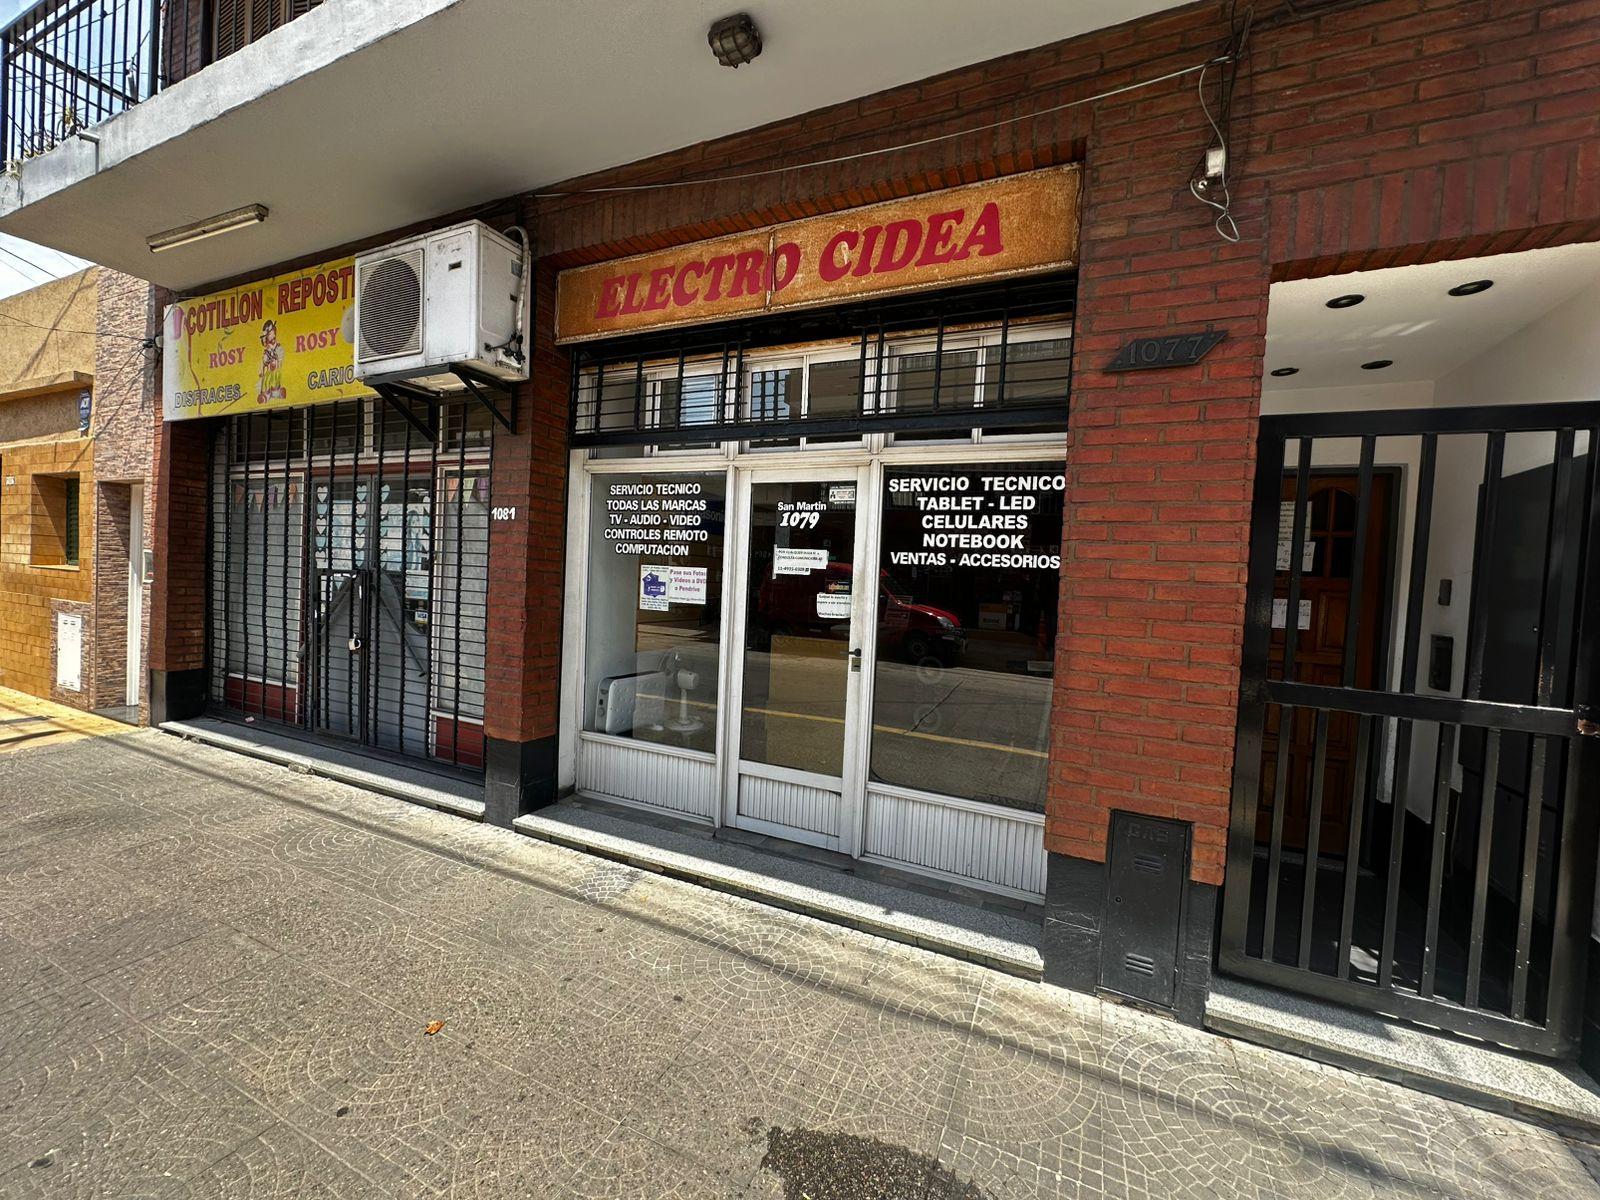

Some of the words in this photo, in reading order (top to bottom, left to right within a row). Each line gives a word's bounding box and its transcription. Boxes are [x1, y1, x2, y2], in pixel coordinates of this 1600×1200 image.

[595, 242, 801, 318] ELECTRO
[818, 201, 1004, 282] CIDEA
[186, 288, 263, 336] COTILLON
[296, 328, 340, 353] ROSY
[209, 347, 246, 369] ROSY
[1129, 336, 1204, 364] 1077
[307, 365, 364, 390] CARIO
[174, 384, 242, 409] DISFRACES
[610, 484, 653, 495] SERVICIO
[656, 483, 701, 495] TECNICO
[888, 476, 970, 492] SERVICIO
[981, 475, 1066, 491] TECNICO
[607, 500, 639, 511] TODAS
[641, 500, 659, 511] LAS
[662, 500, 707, 511] MARCAS
[777, 502, 794, 511] San
[796, 501, 827, 511] Martin
[917, 496, 984, 511] TABLET
[999, 495, 1036, 511] LED
[491, 506, 516, 521] 1081
[610, 514, 622, 525] TV
[629, 515, 661, 525] AUDIO
[669, 515, 701, 525] VIDEO
[780, 512, 820, 529] 1079
[921, 515, 1028, 530] CELULARES
[604, 529, 661, 540] CONTROLES
[663, 529, 708, 541] REMOTO
[922, 533, 1025, 550] NOTEBOOK
[615, 543, 689, 556] COMPUTACION
[890, 551, 947, 566] VENTAS
[958, 553, 1061, 569] ACCESORIOS
[669, 568, 682, 576] Pase
